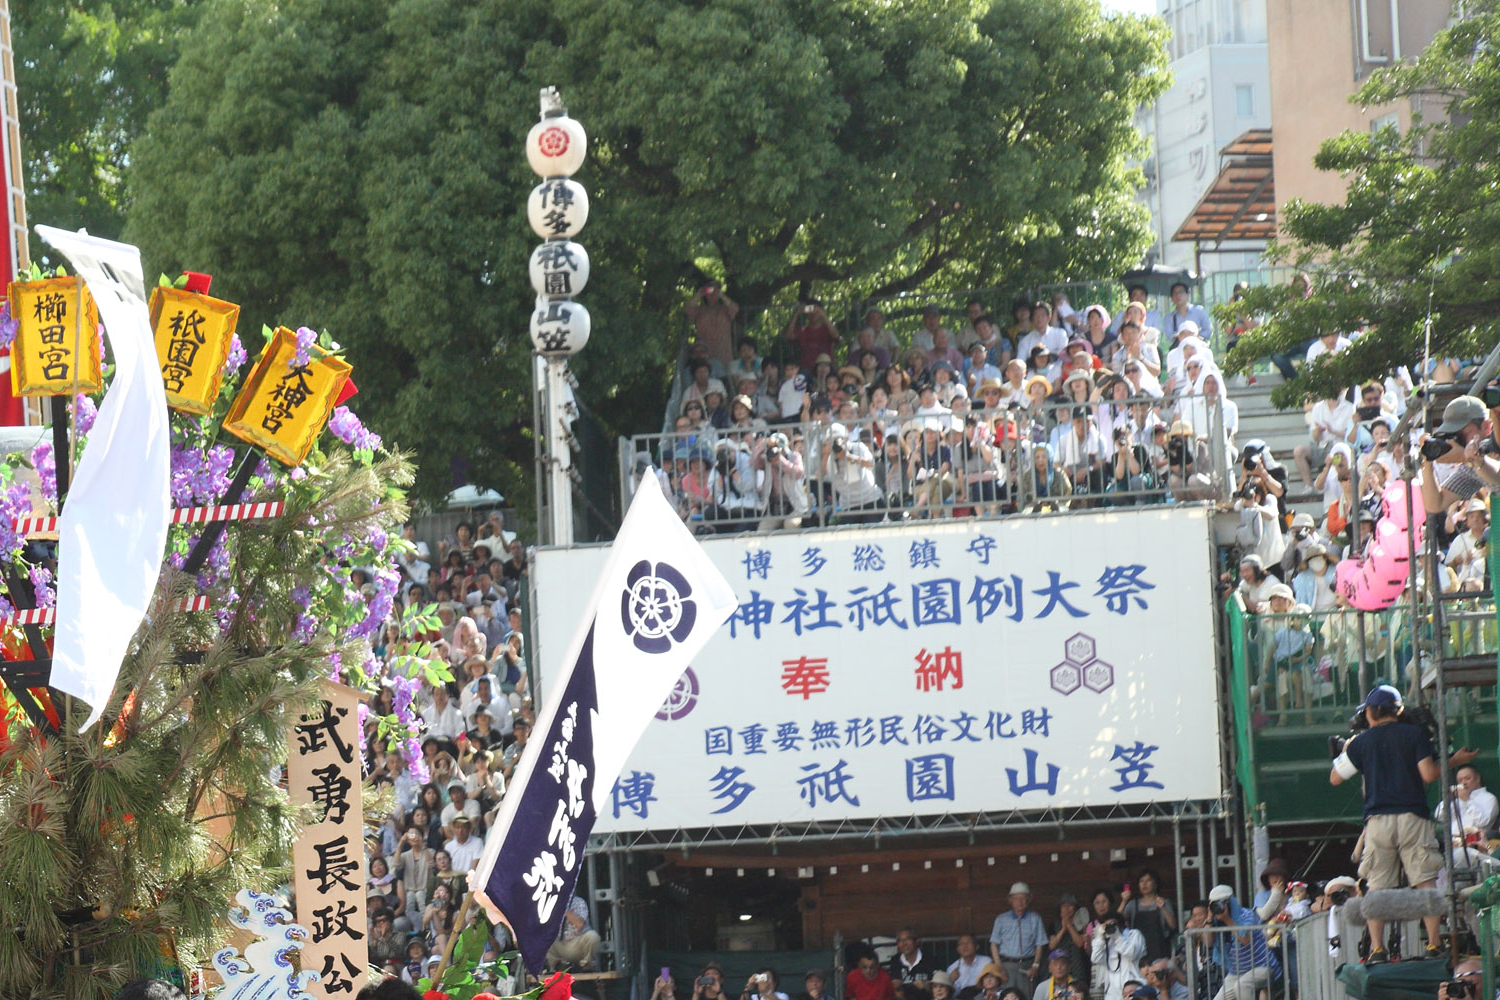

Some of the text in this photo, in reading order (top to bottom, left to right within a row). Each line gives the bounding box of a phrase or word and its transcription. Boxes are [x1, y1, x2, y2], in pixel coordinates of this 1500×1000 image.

[538, 183, 578, 351] 博多祇園山笠
[33, 294, 71, 381] 櫛田宮
[163, 309, 206, 394] 祇園宮
[742, 534, 997, 579] 博多総鎮守
[725, 564, 1157, 640] 神社祇園例大祭
[781, 645, 964, 700] 奉納
[704, 706, 1053, 756] 国重要無形民俗文化財
[609, 741, 1165, 820] 博多祇園山笠
[295, 700, 364, 995] 武勇長政公
